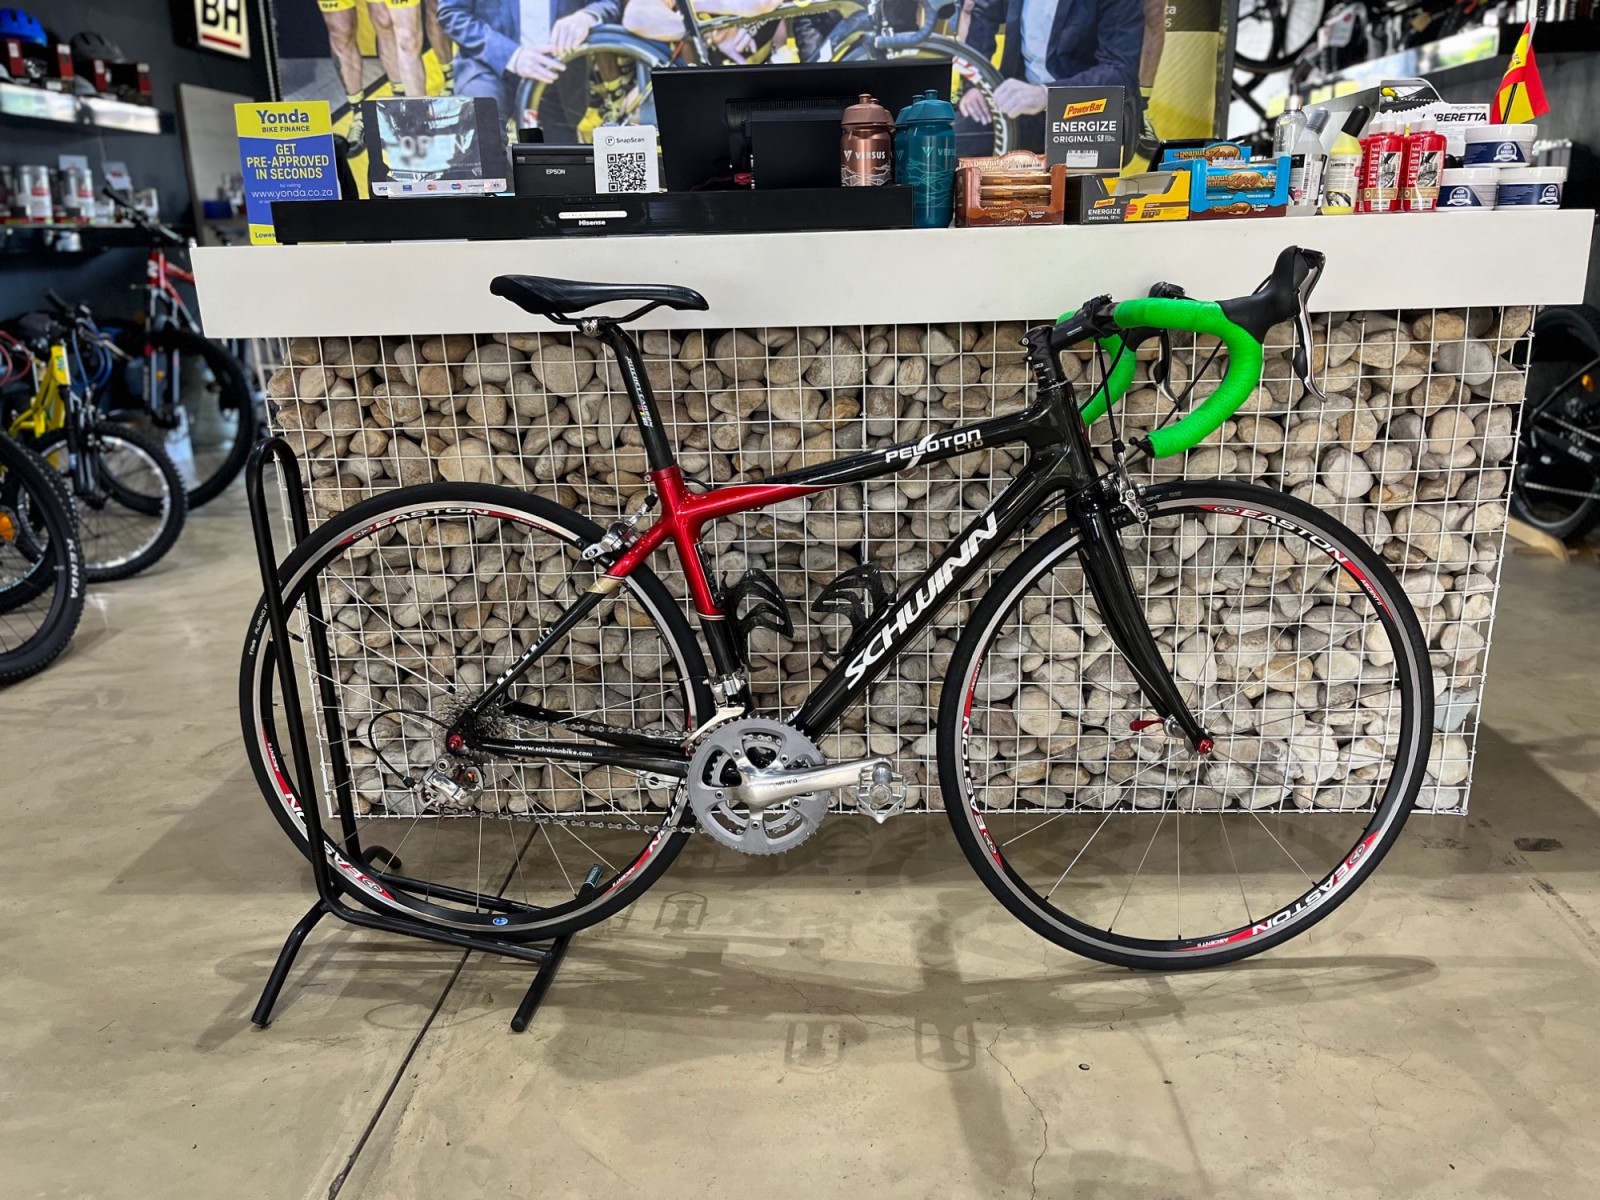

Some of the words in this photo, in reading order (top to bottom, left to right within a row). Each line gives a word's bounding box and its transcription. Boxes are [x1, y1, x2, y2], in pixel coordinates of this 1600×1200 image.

[202, 0, 241, 34] BH
[256, 108, 310, 124] Yonda
[1067, 102, 1104, 115] PowerBar
[1421, 112, 1487, 122] BERETTA
[1052, 120, 1117, 132] ENERGIZE
[1053, 135, 1094, 144] ORIGINAL
[275, 143, 296, 155] GET
[855, 150, 886, 159] VERSUS
[246, 155, 330, 168] PRE-APPROVED
[1369, 147, 1380, 185] SMOOVE
[1408, 146, 1421, 185] SMOOVE
[255, 169, 268, 180] IN
[270, 167, 323, 180] SECONDS
[251, 188, 333, 199] www.yonda.co.za
[1087, 208, 1121, 216] ENERGIZE
[885, 429, 981, 463] PELOTON
[955, 439, 984, 453] LTD
[375, 507, 491, 528] EASTON
[1239, 509, 1349, 563] EASTON
[66, 538, 79, 598] KENDA
[1360, 578, 1378, 602] ASCENT
[845, 511, 998, 690] SCHWINN
[514, 744, 593, 757] www.schwinnbike.com
[961, 716, 986, 830] EASTON
[1252, 863, 1350, 935] EASTON
